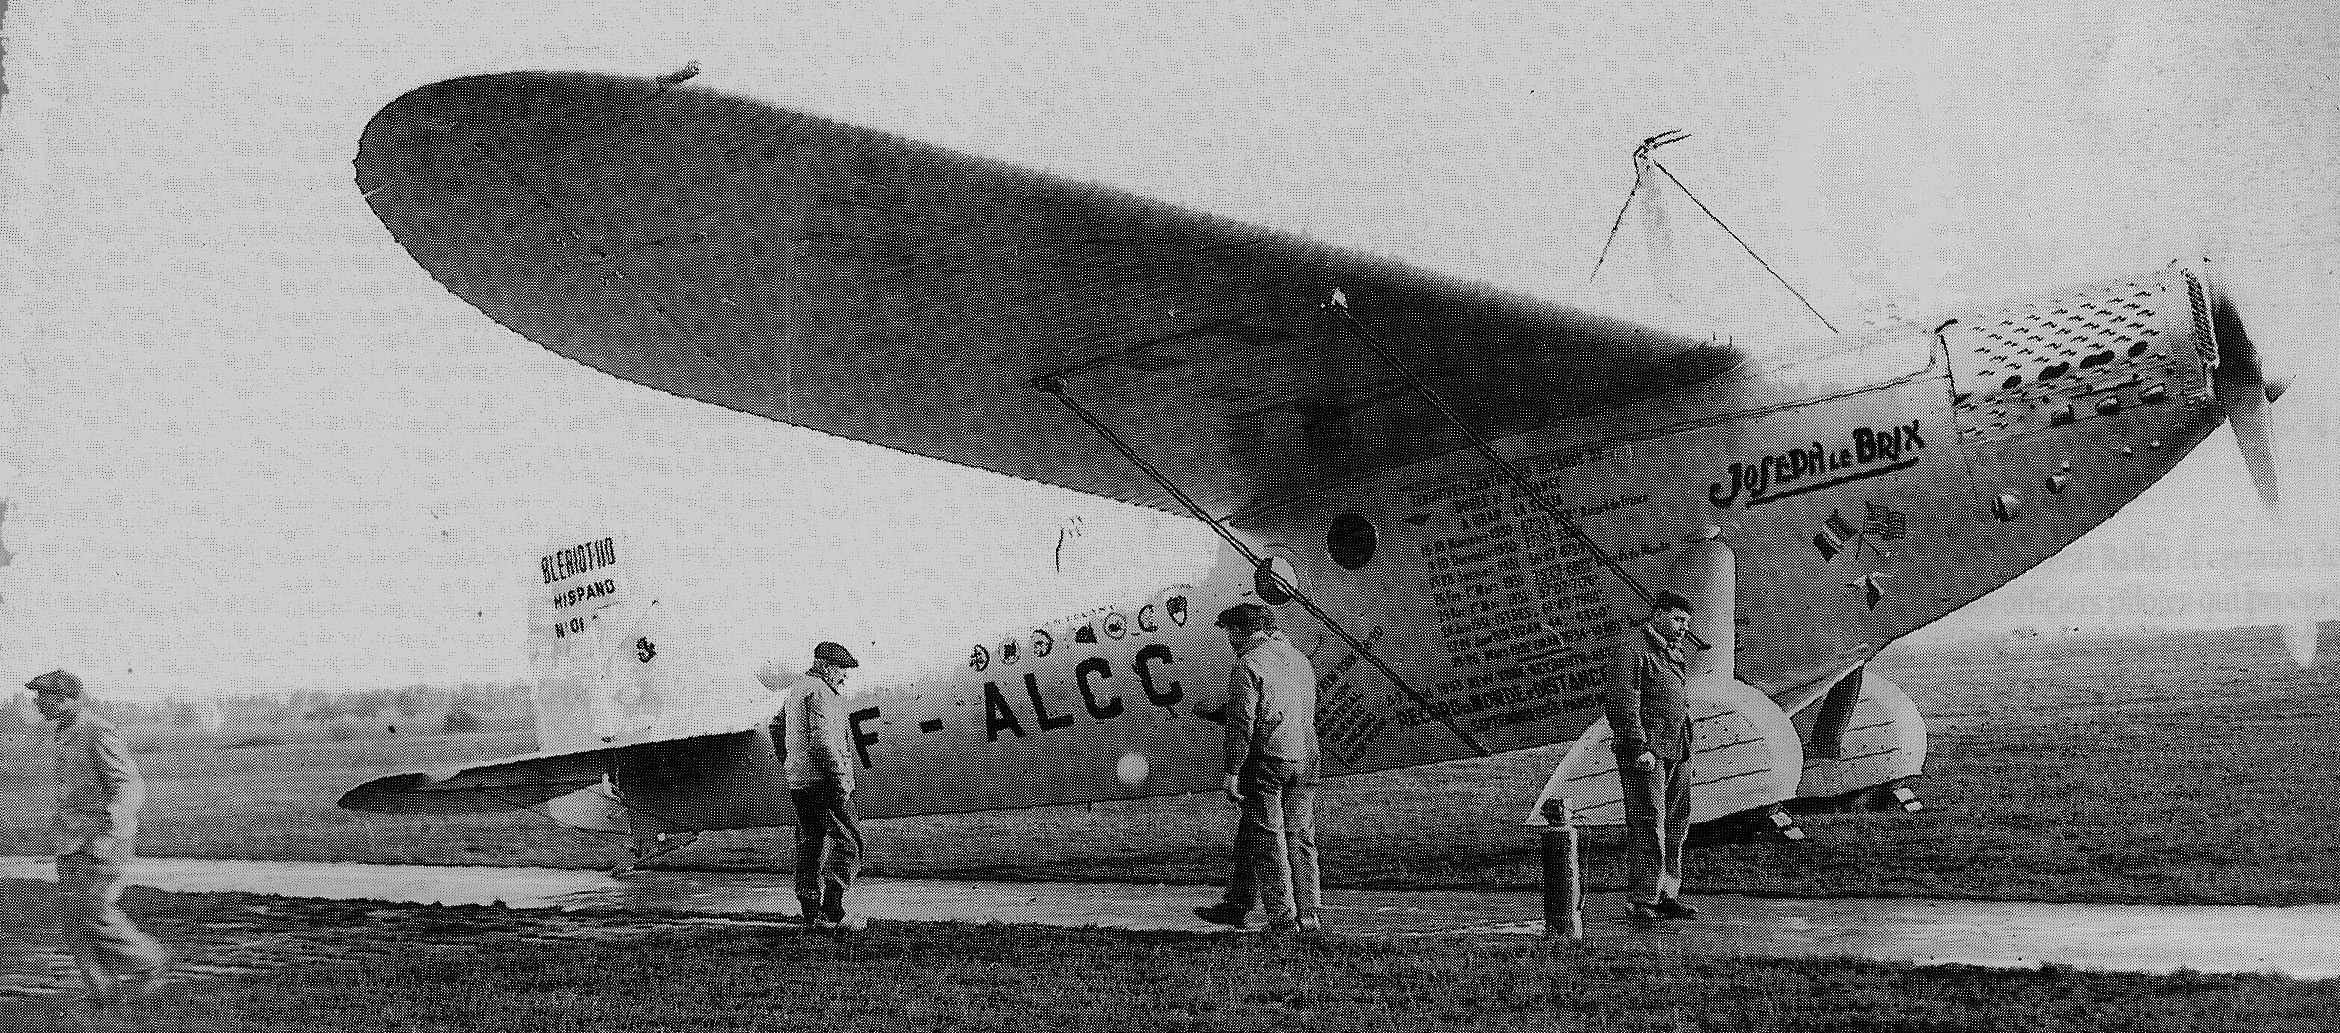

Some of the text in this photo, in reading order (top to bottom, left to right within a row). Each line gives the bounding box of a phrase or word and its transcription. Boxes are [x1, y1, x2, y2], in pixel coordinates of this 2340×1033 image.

[1709, 441, 1825, 509] JOSEPH
[1852, 418, 1926, 463] BRIX
[553, 578, 616, 610] HISPANO
